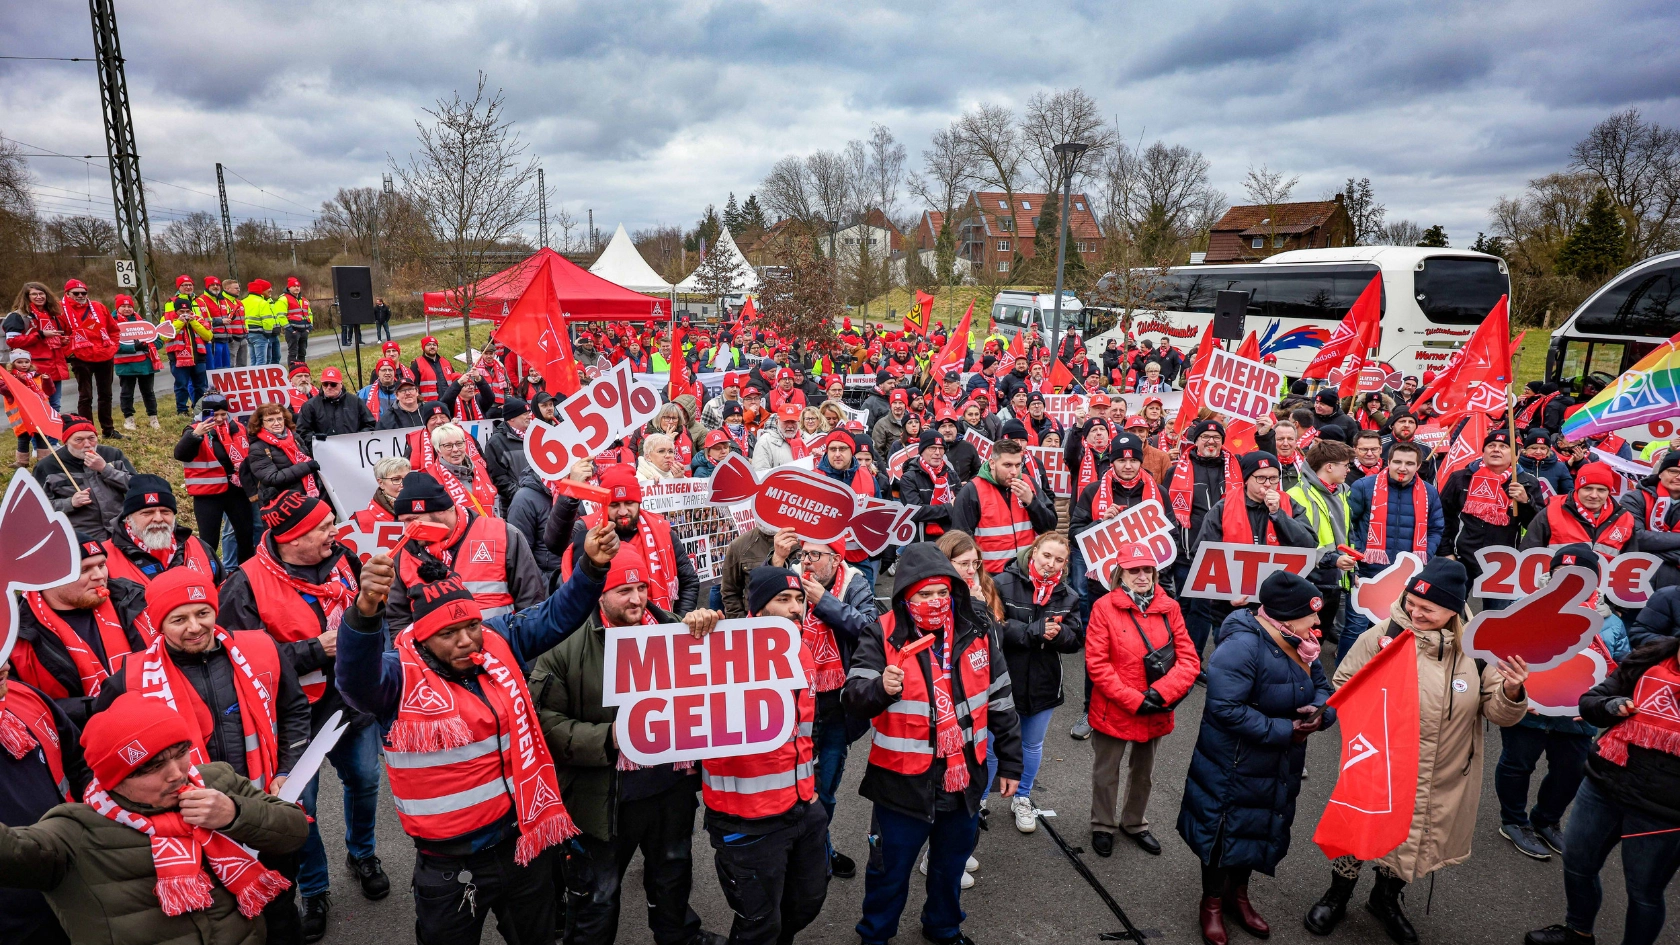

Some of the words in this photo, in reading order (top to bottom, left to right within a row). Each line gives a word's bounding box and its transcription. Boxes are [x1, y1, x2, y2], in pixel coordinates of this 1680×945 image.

[116, 261, 134, 273] 84
[122, 273, 131, 285] 8
[1415, 350, 1449, 360] Werner
[211, 367, 287, 393] MEHR
[1209, 353, 1280, 398] MEHR
[1208, 382, 1269, 420] GELD
[358, 438, 383, 468] IG
[665, 482, 691, 494] ZEIGEN
[764, 486, 843, 519] MITGLIEDER-
[777, 503, 822, 526] BONUS
[1082, 503, 1167, 564] MEHR
[615, 626, 794, 694] MEHR
[627, 687, 784, 755] GELD
